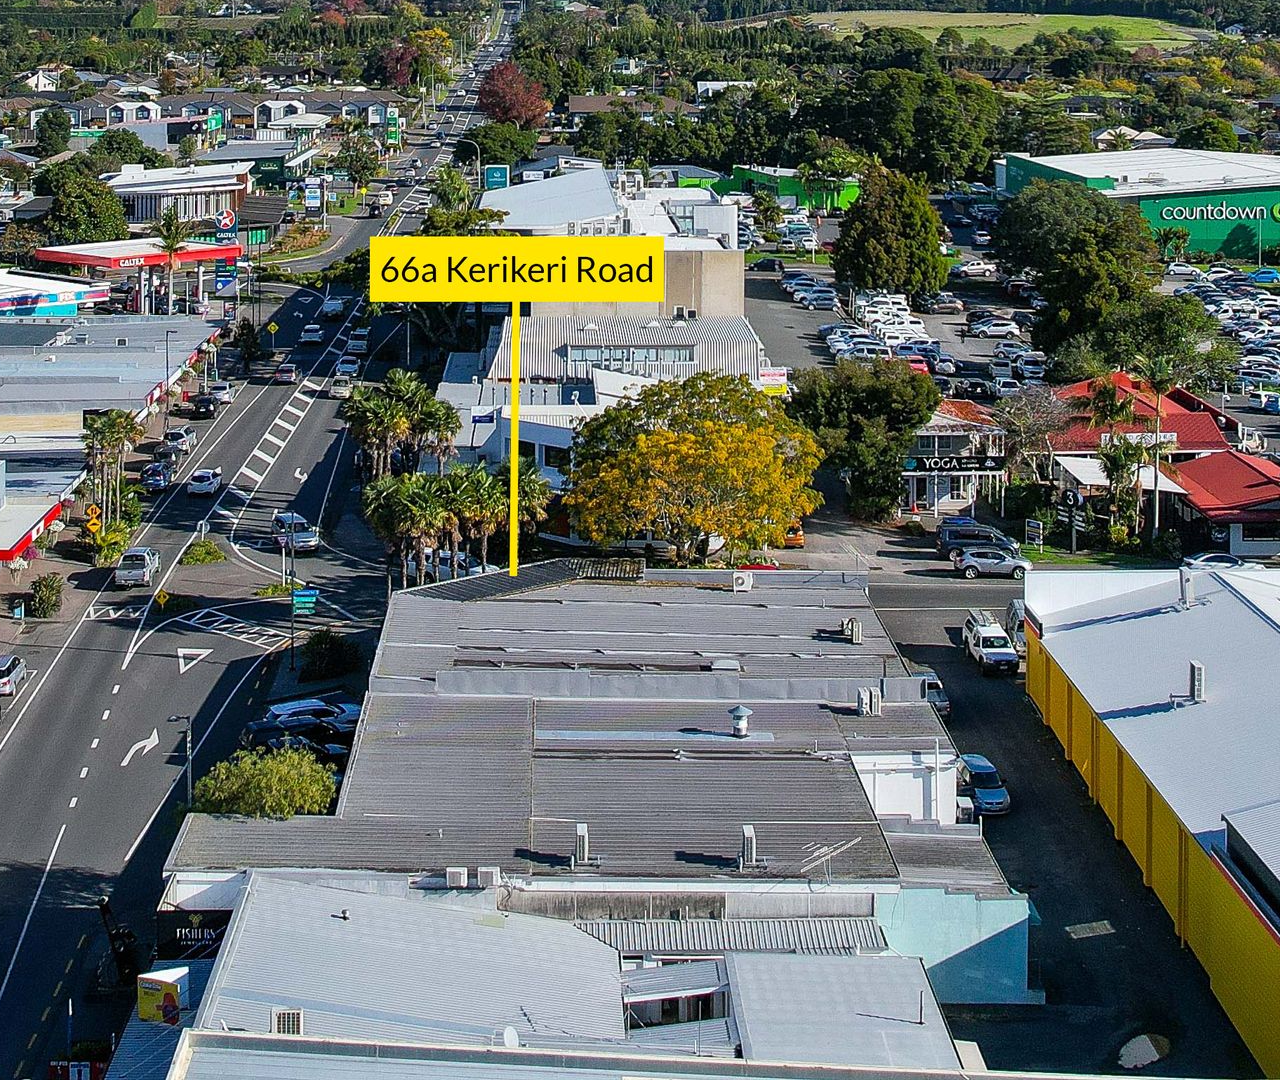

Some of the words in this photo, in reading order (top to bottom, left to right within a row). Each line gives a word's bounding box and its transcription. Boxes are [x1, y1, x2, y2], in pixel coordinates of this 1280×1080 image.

[1162, 201, 1267, 220] countdown
[119, 258, 145, 266] CALTEX
[923, 458, 960, 469] YOGA
[1066, 491, 1074, 505] 3
[176, 928, 216, 939] FISHERS
